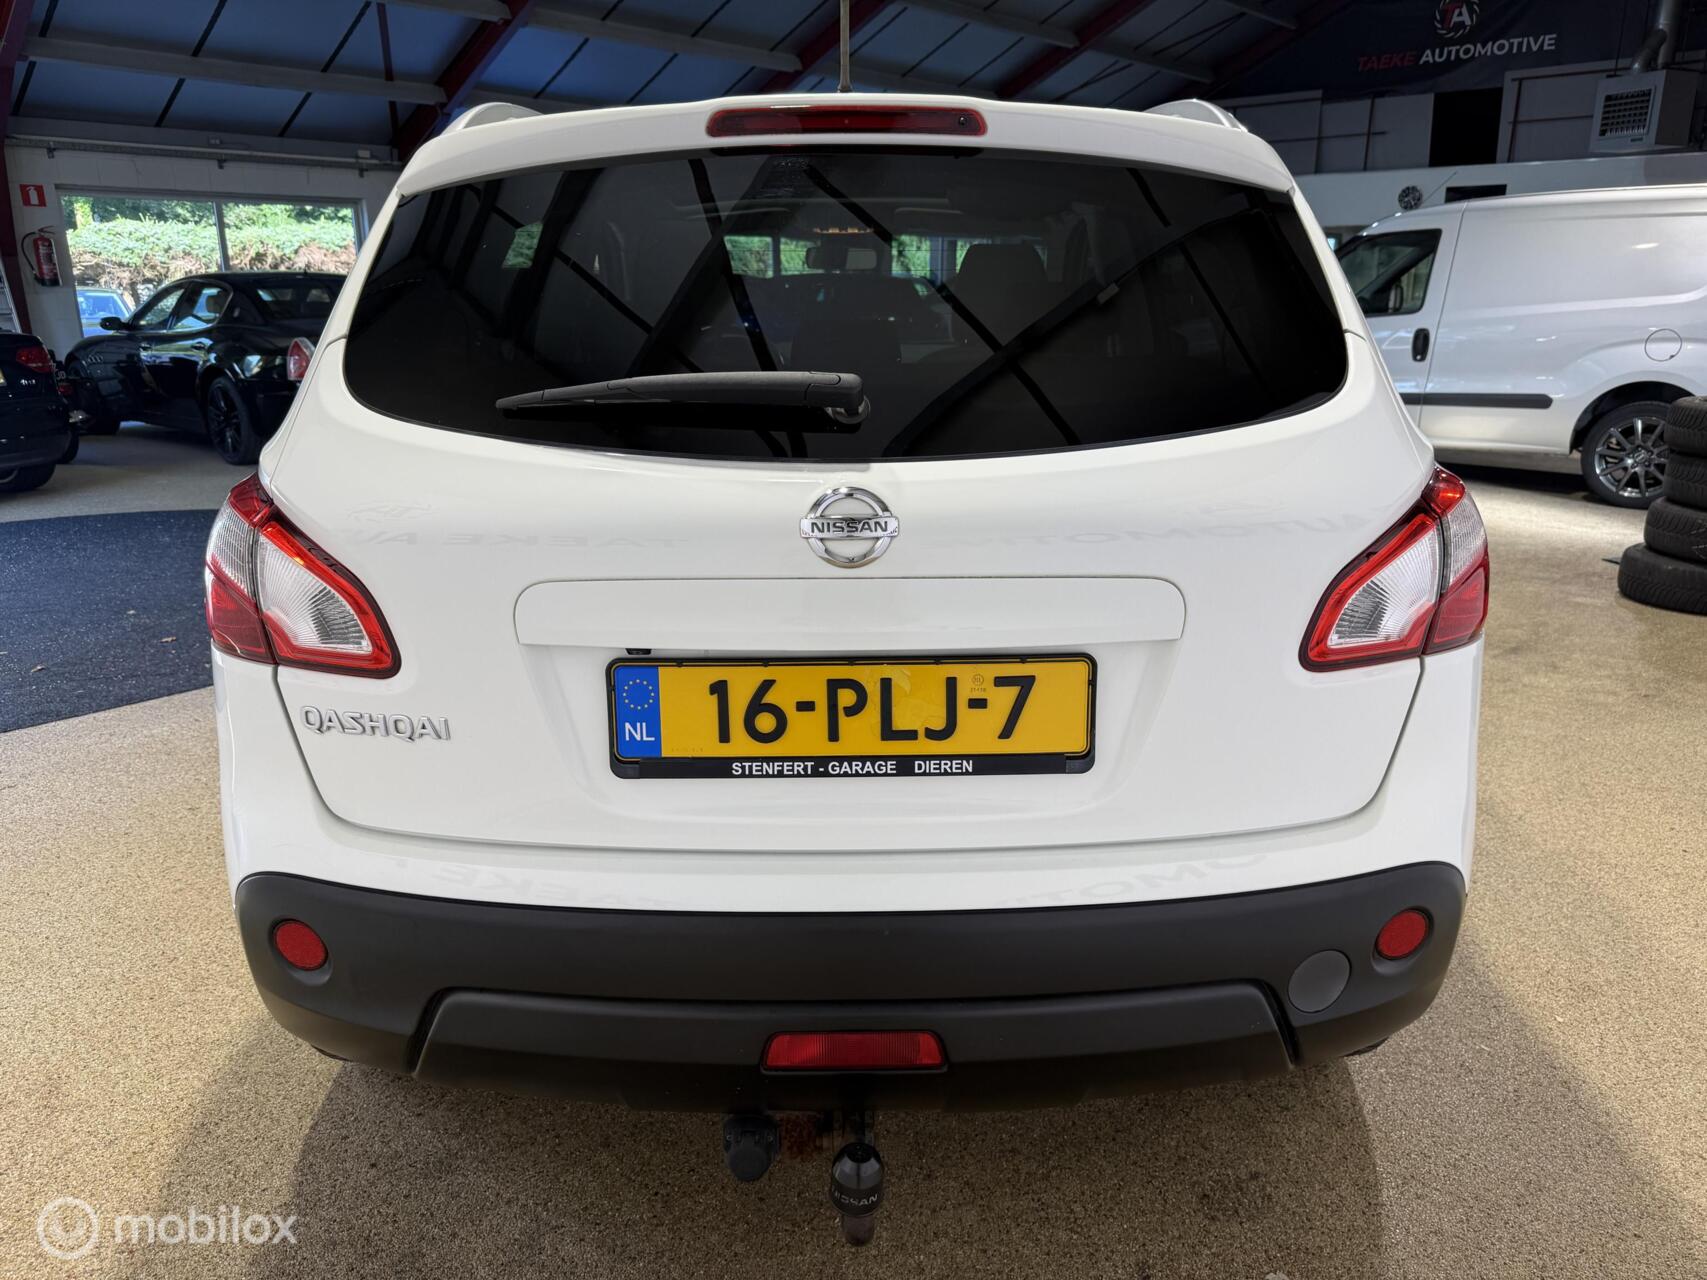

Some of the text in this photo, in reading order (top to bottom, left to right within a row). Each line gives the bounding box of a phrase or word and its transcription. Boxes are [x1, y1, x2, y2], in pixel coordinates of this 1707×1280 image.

[1357, 34, 1557, 72] TAEKE AUTOMOTIVE
[810, 520, 888, 534] NISSAN
[708, 674, 1037, 744] 16-PLJ-7
[301, 705, 451, 742] QASHQAI
[624, 722, 655, 741] NL
[731, 761, 815, 776] STENFERT
[828, 760, 897, 774] GARAGE
[914, 759, 973, 774] DIEREN
